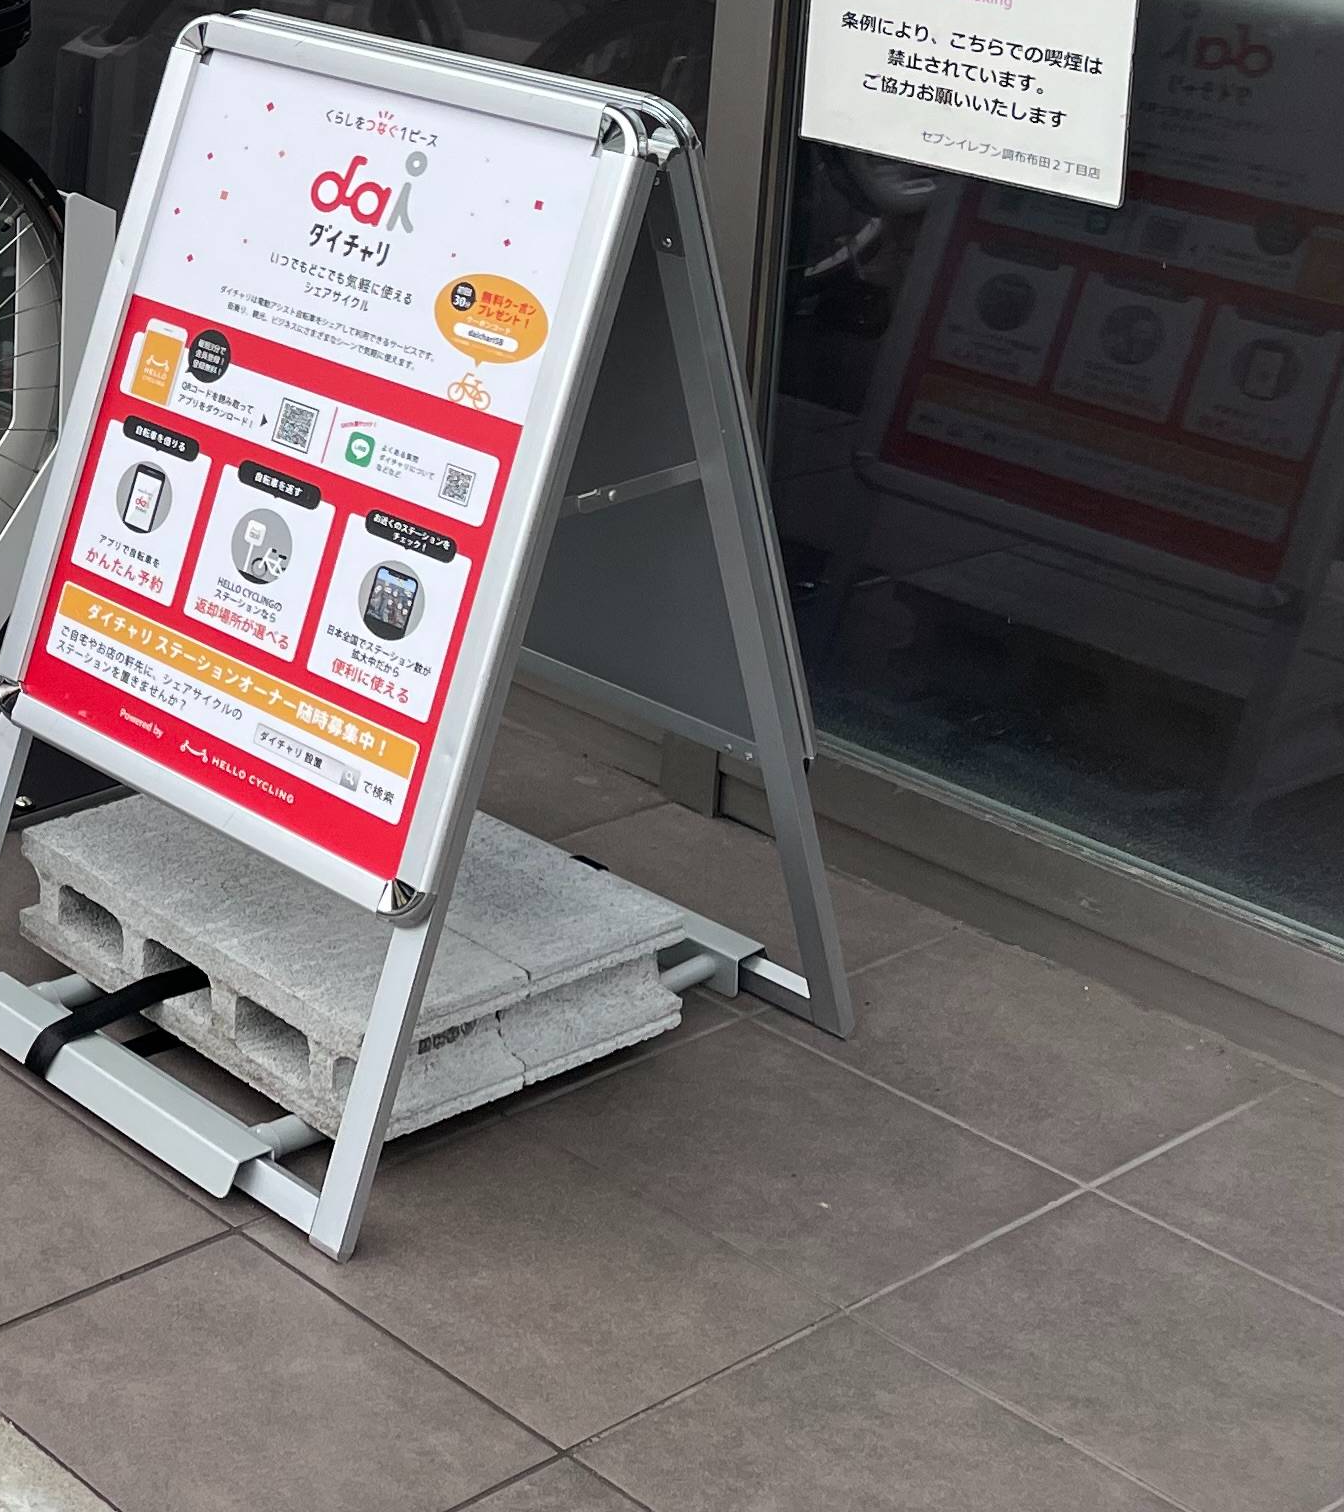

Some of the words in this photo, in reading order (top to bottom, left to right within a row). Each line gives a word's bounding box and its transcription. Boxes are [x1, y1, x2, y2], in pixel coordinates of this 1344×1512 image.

[841, 10, 1104, 75] 条例により、こちらでの喫煙は
[887, 48, 1044, 95] 禁止されています。
[862, 72, 1067, 128] ご協力お願いいたします
[309, 222, 392, 268] ダイチャリ
[269, 251, 414, 307] いつでもどこでも気軽に使える
[302, 279, 370, 313] シェアサイクル
[85, 547, 164, 595] かんたん予約
[98, 534, 160, 569] アプリで自転車を
[213, 588, 277, 624] ステーションなら
[217, 576, 241, 596] HELLO
[87, 603, 153, 646] ダイチャリ
[193, 596, 289, 650] 返却場所が選べる
[60, 625, 243, 721] ご自宅やお店の軒先に、シェアサイクルの
[326, 624, 432, 677] 日本全国でステーション数が
[351, 649, 400, 678] 拡大中だから
[55, 638, 188, 711] ステーションを置きませんか？
[331, 657, 409, 705] 便利に使える
[119, 708, 152, 734] Powered
[151, 723, 164, 739] by
[260, 731, 302, 759] ダイチャリ
[212, 756, 247, 780] HELLO
[247, 774, 295, 805] CYCLING
[362, 780, 395, 806] で検索
